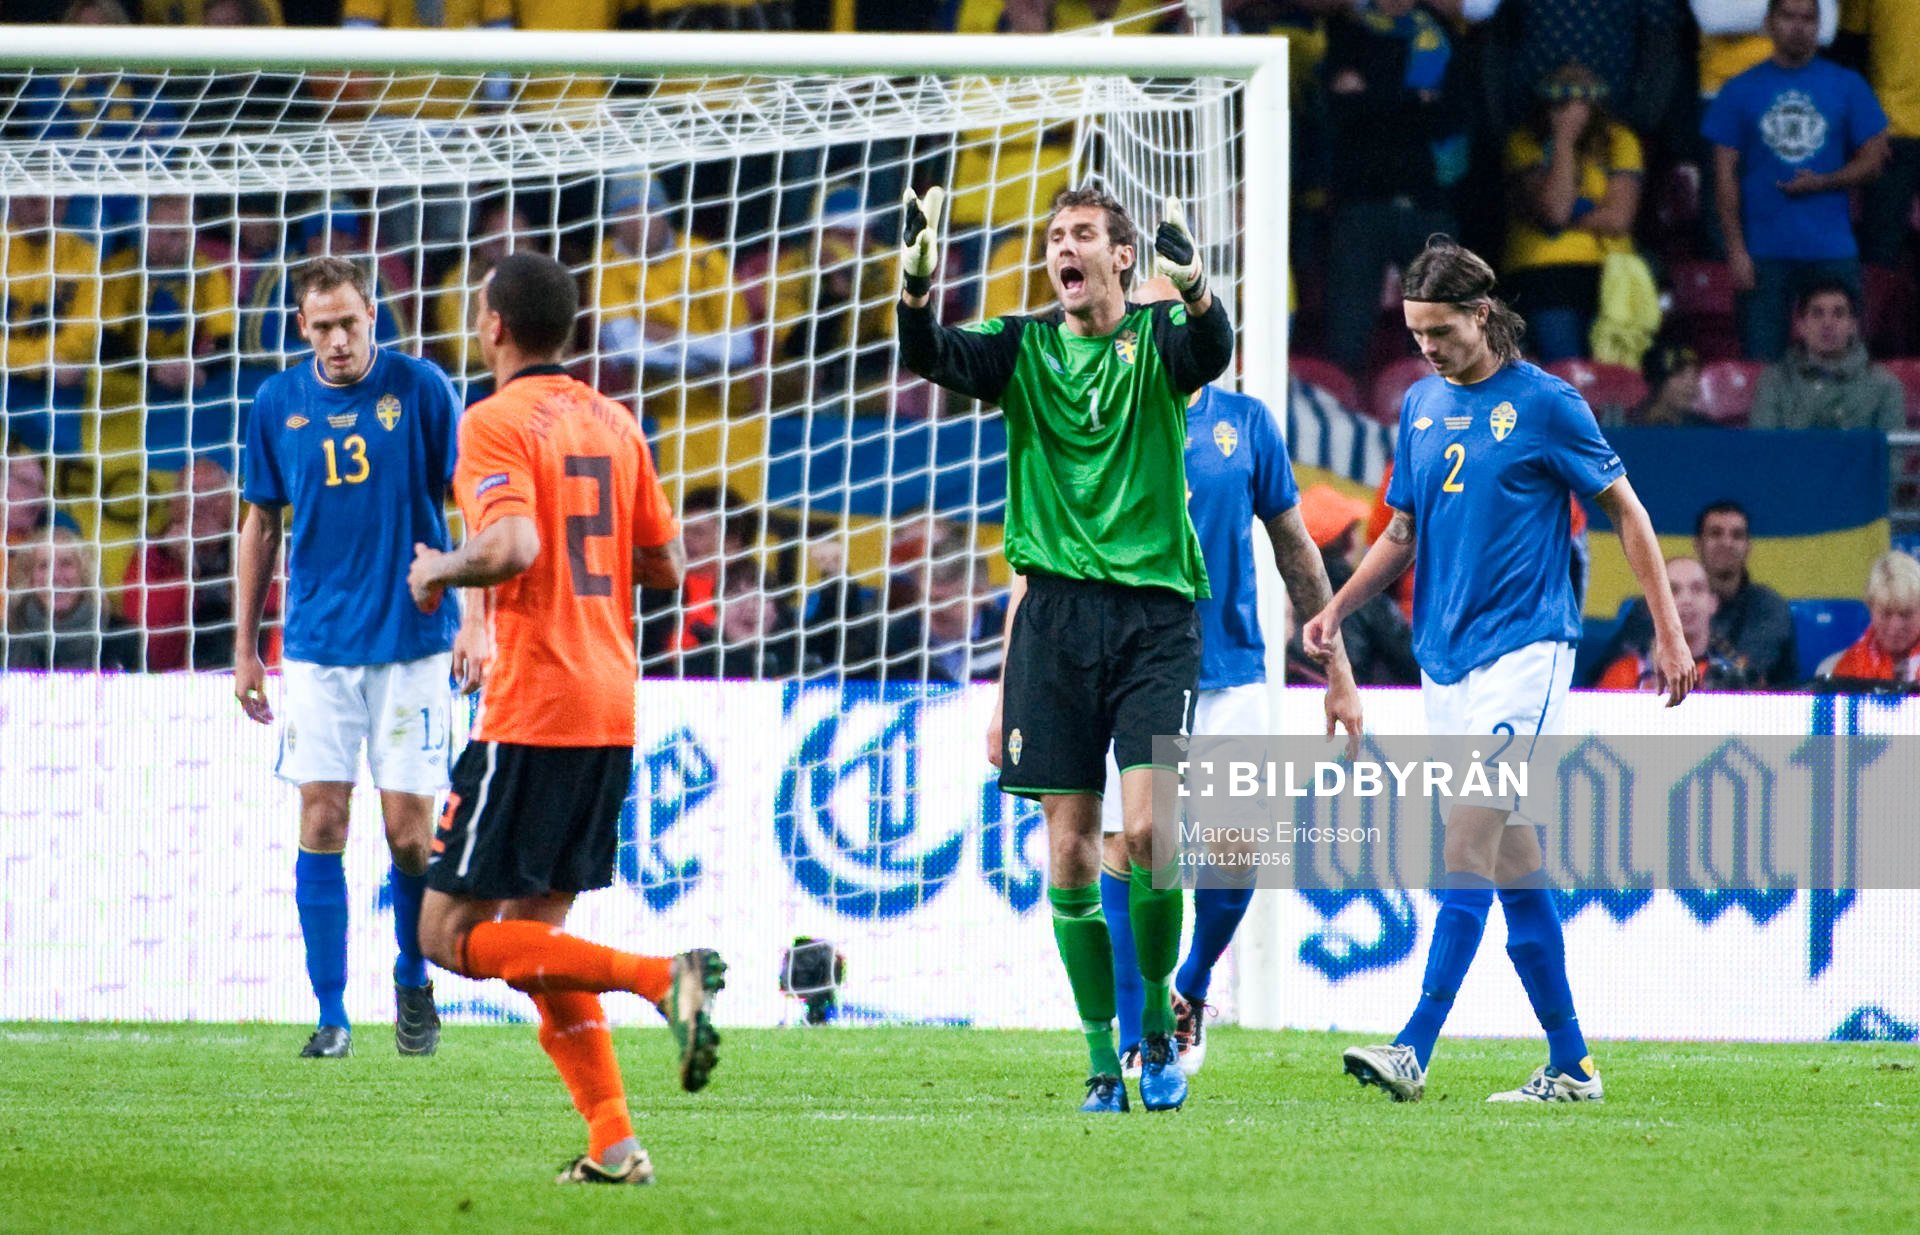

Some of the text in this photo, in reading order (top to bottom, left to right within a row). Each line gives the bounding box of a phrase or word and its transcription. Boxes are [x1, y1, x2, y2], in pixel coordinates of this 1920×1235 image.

[1087, 387, 1106, 433] 1
[322, 434, 370, 486] 13
[1442, 443, 1466, 493] 2
[565, 455, 612, 597] 2
[1179, 689, 1191, 736] 1
[1484, 721, 1515, 769] 2
